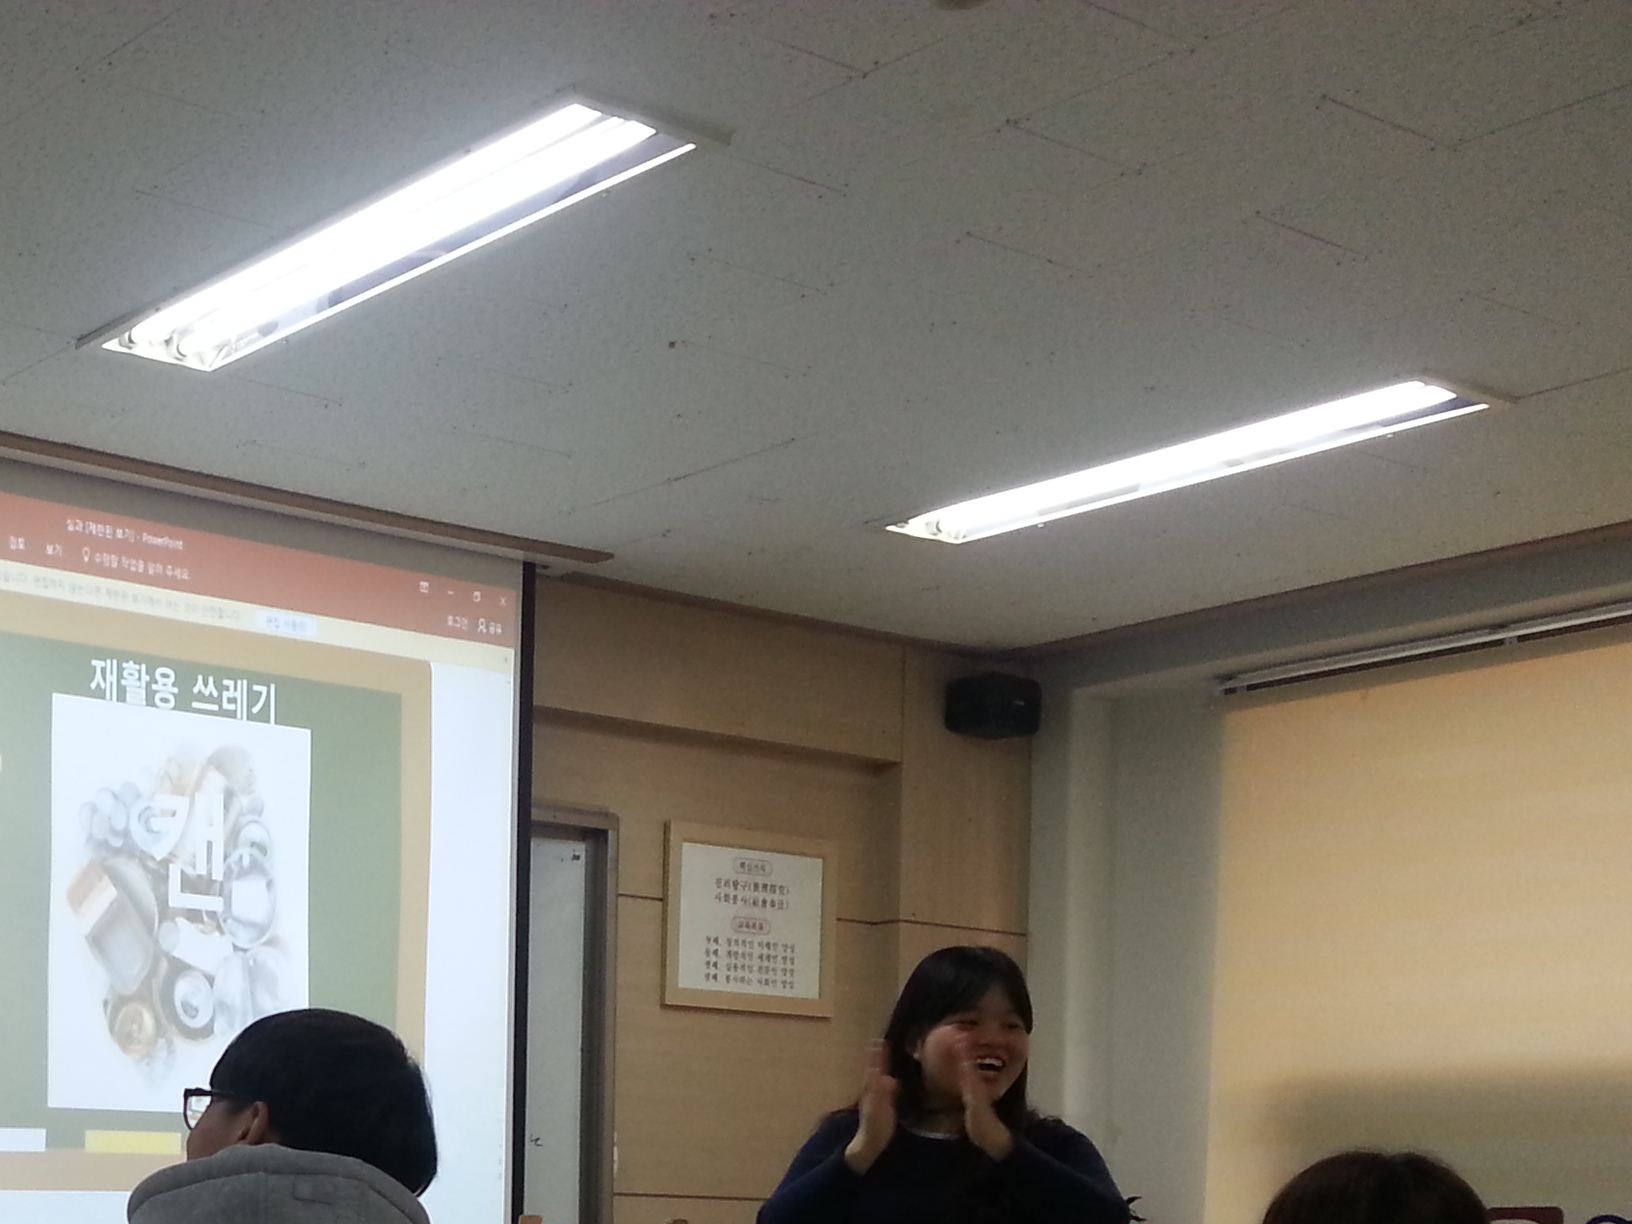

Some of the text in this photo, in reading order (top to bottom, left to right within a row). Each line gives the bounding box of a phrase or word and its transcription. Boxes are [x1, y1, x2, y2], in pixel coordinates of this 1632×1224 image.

[142, 532, 184, 551] PowerPoint
[89, 656, 277, 725] 재활용 쓰레기
